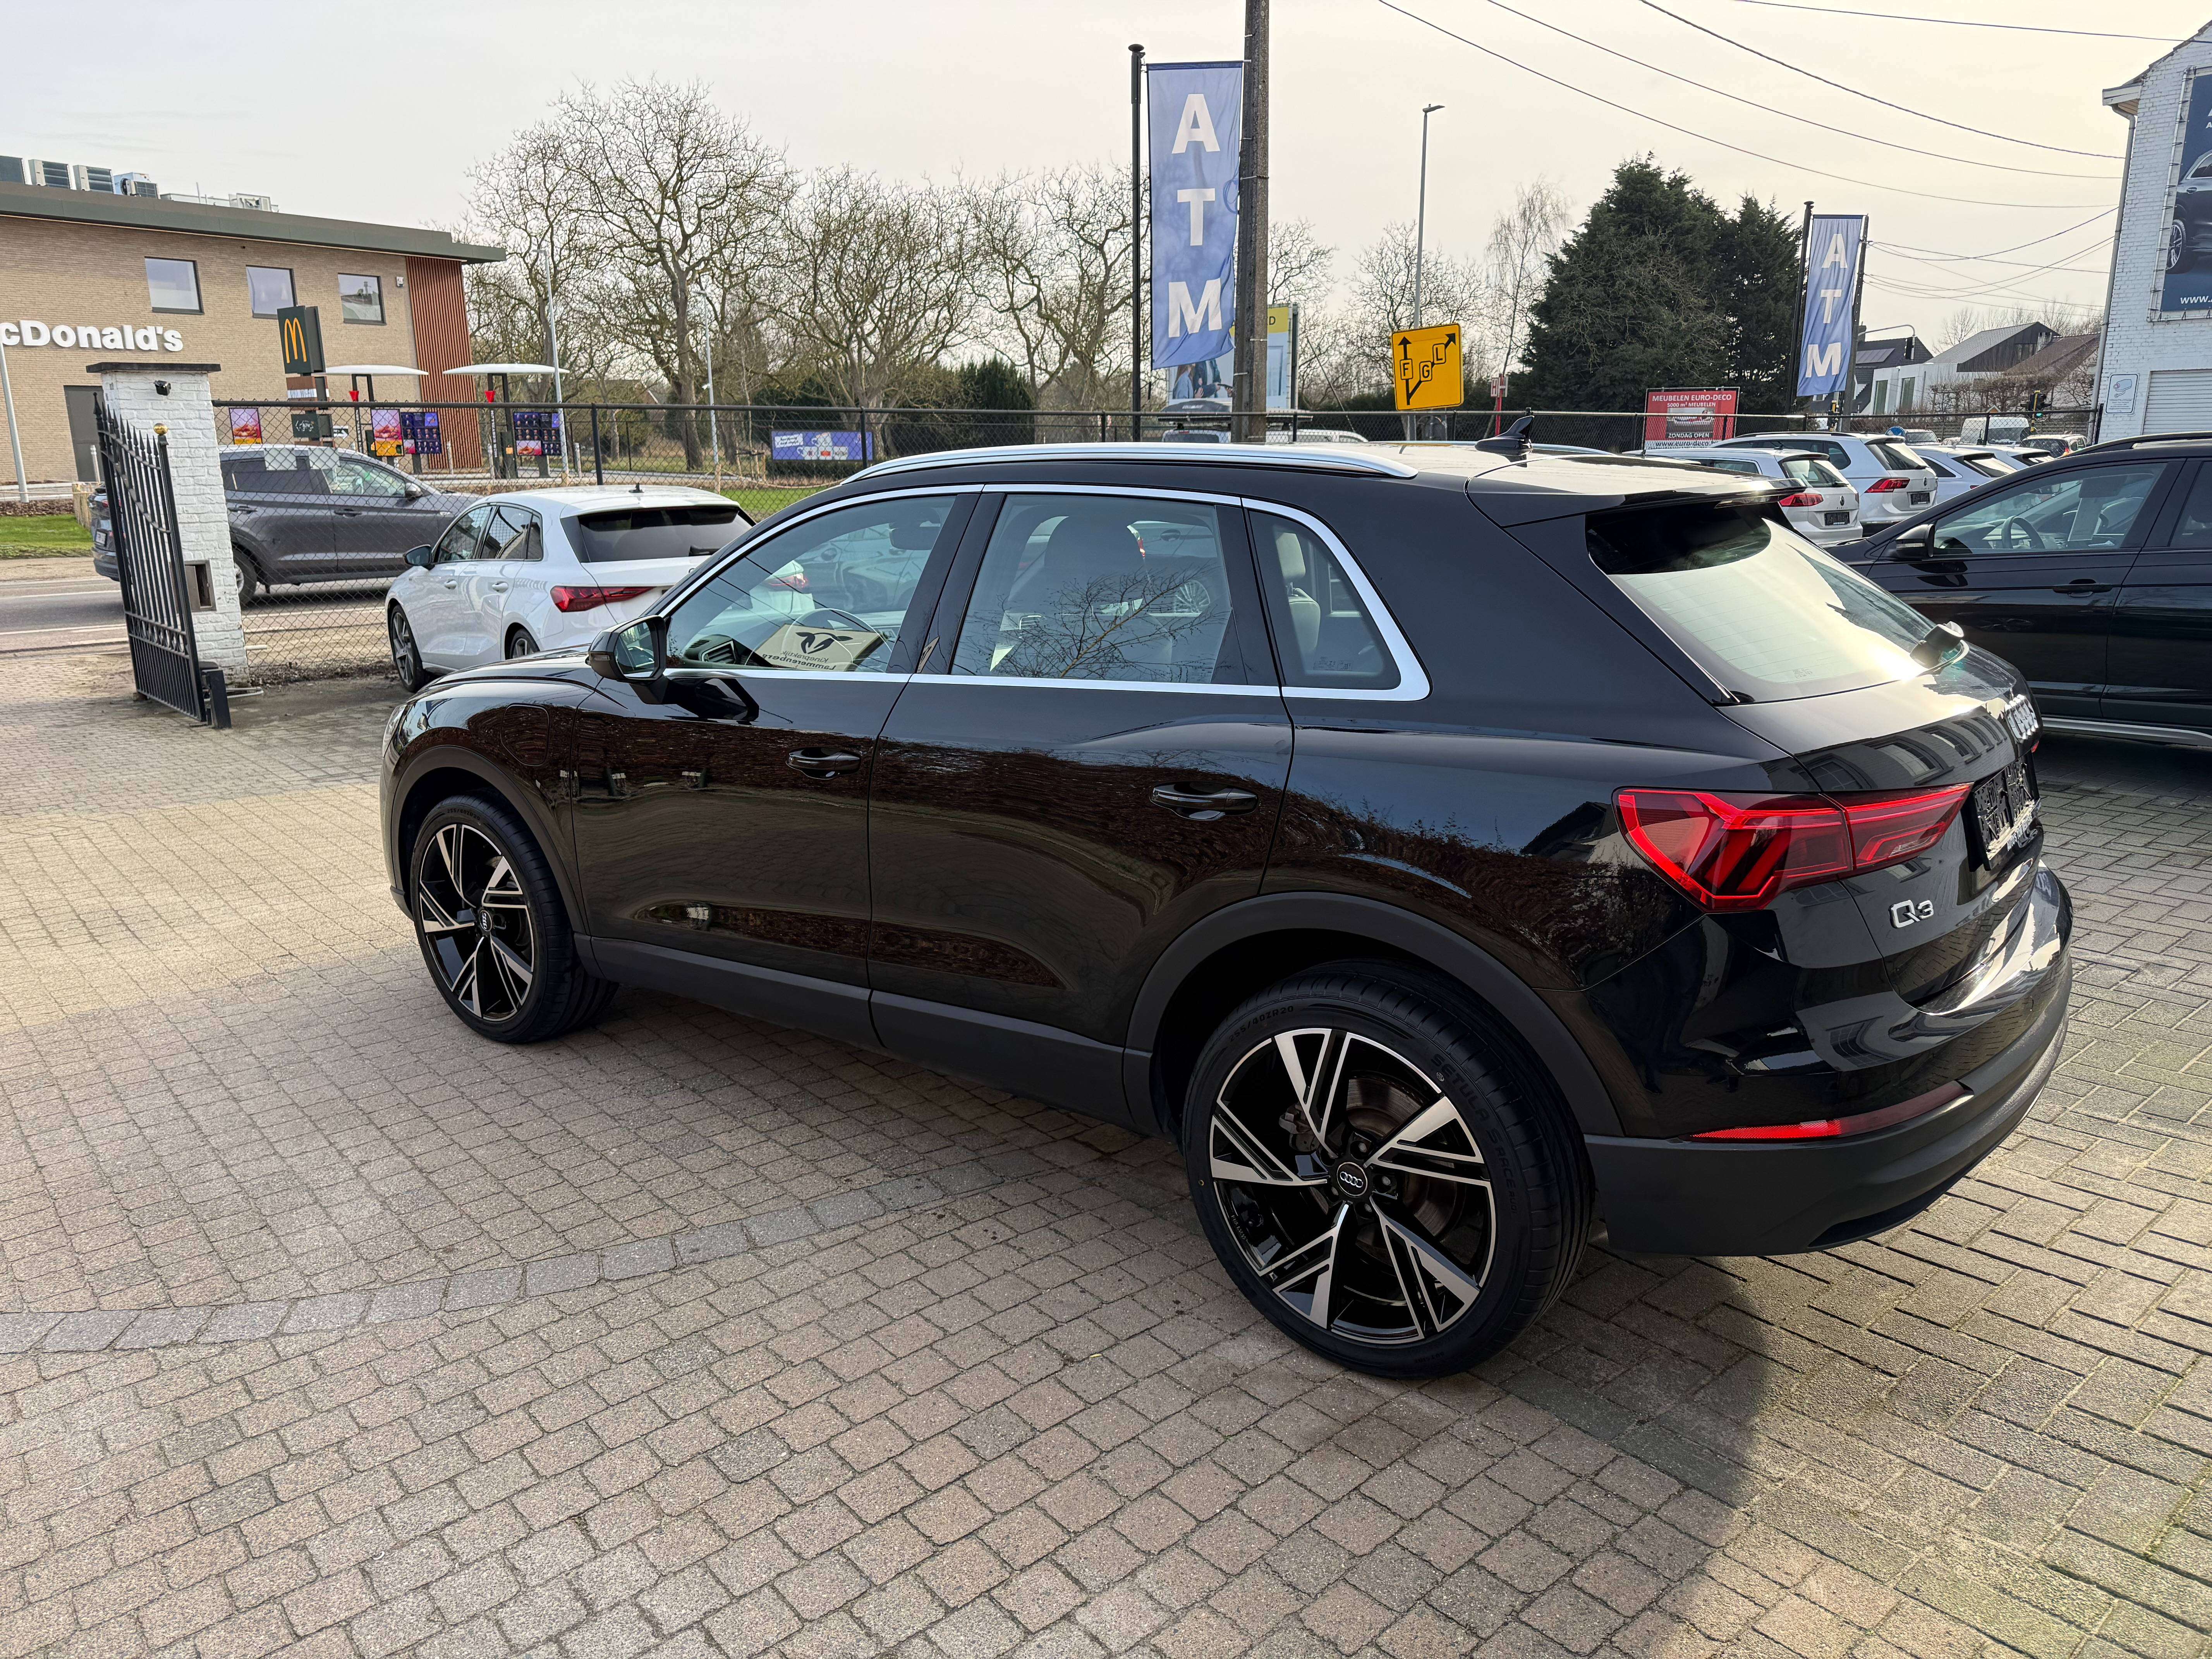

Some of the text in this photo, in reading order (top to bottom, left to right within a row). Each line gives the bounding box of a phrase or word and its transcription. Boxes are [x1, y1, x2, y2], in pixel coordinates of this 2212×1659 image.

[1436, 347, 1443, 361] L
[1403, 362, 1410, 376] F
[1422, 364, 1430, 378] G
[1889, 899, 1934, 928] Q3
[1229, 1006, 1294, 1042] 255/40ZR20
